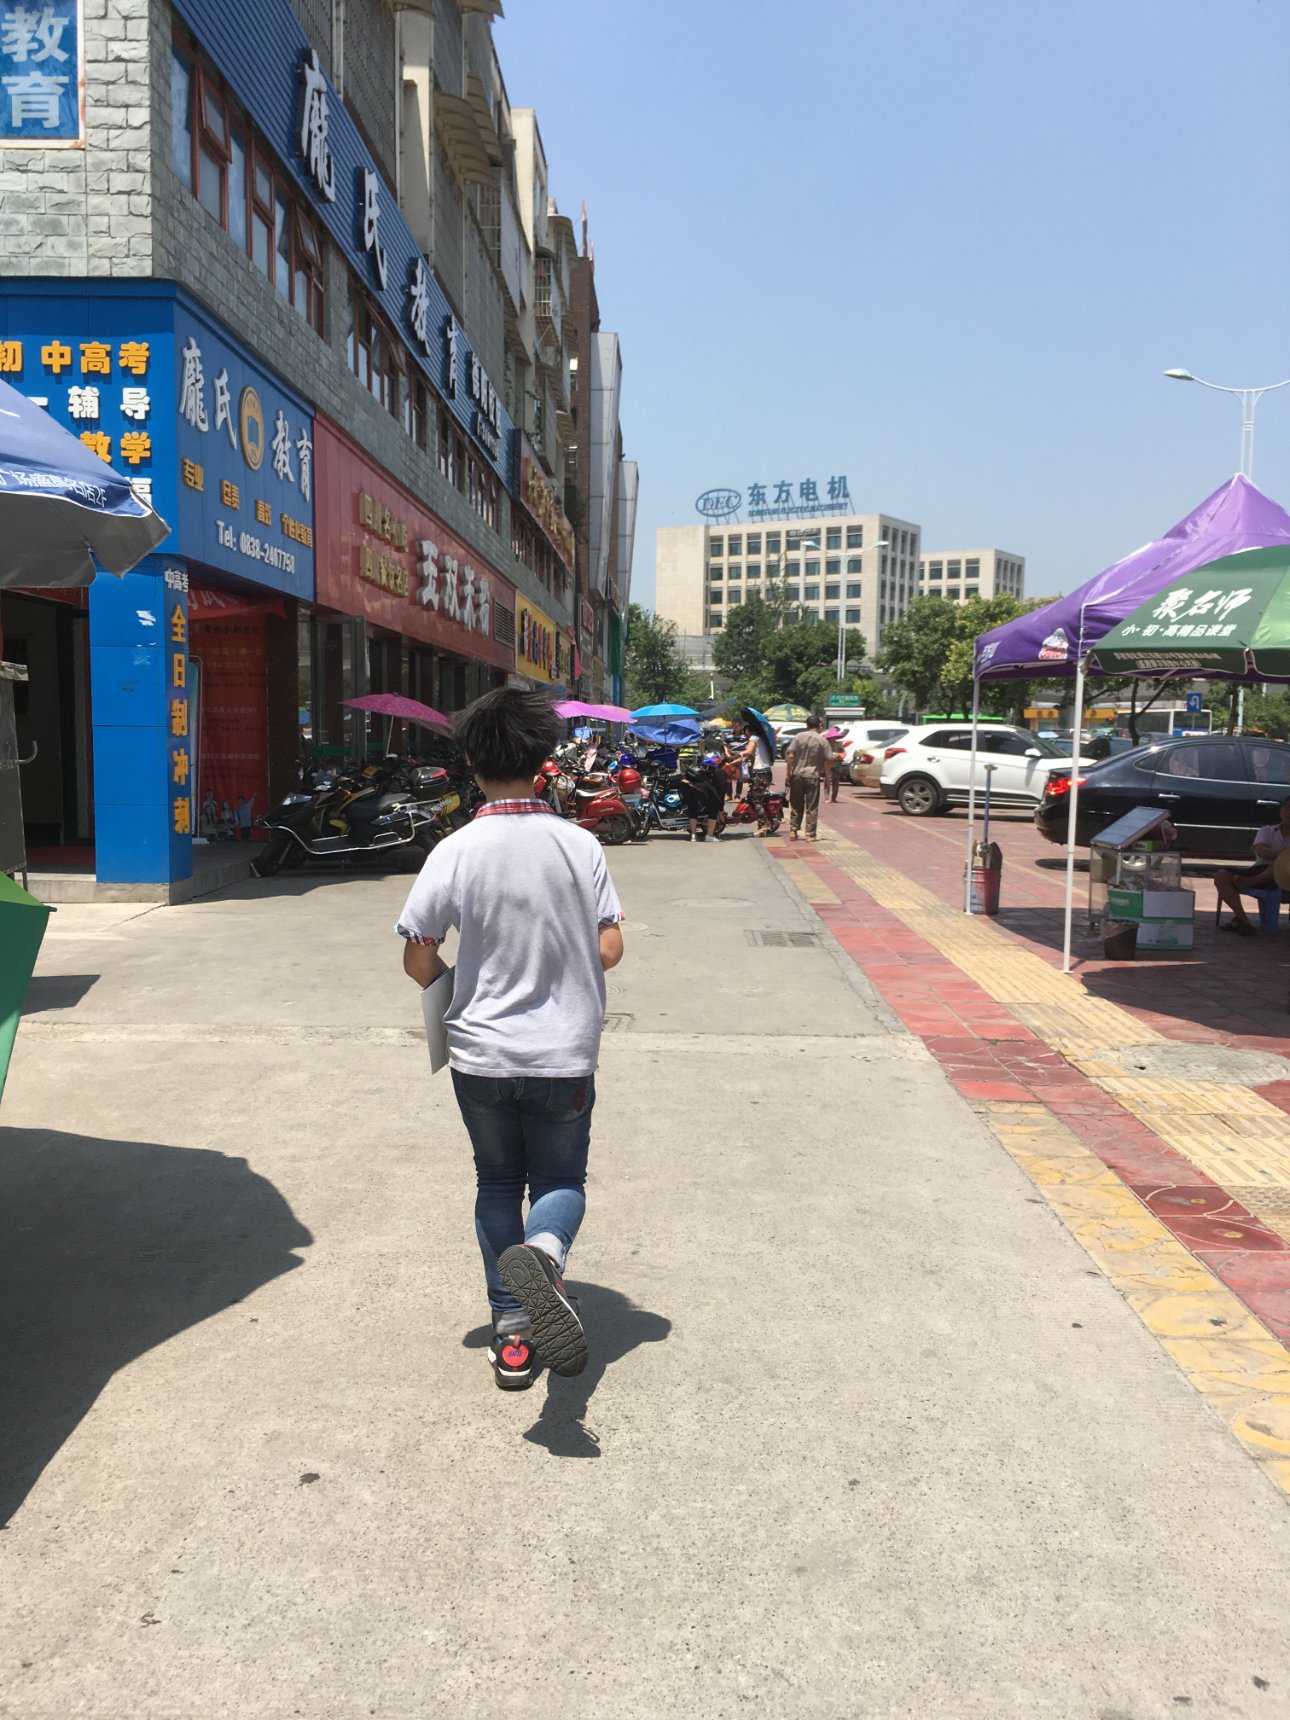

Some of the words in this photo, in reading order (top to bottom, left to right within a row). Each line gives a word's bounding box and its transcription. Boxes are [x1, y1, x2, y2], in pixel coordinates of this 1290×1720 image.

[1, 6, 70, 129] 教育
[747, 475, 850, 507] 东方电机
[216, 519, 237, 552] Tel:
[164, 567, 189, 593] 中高考
